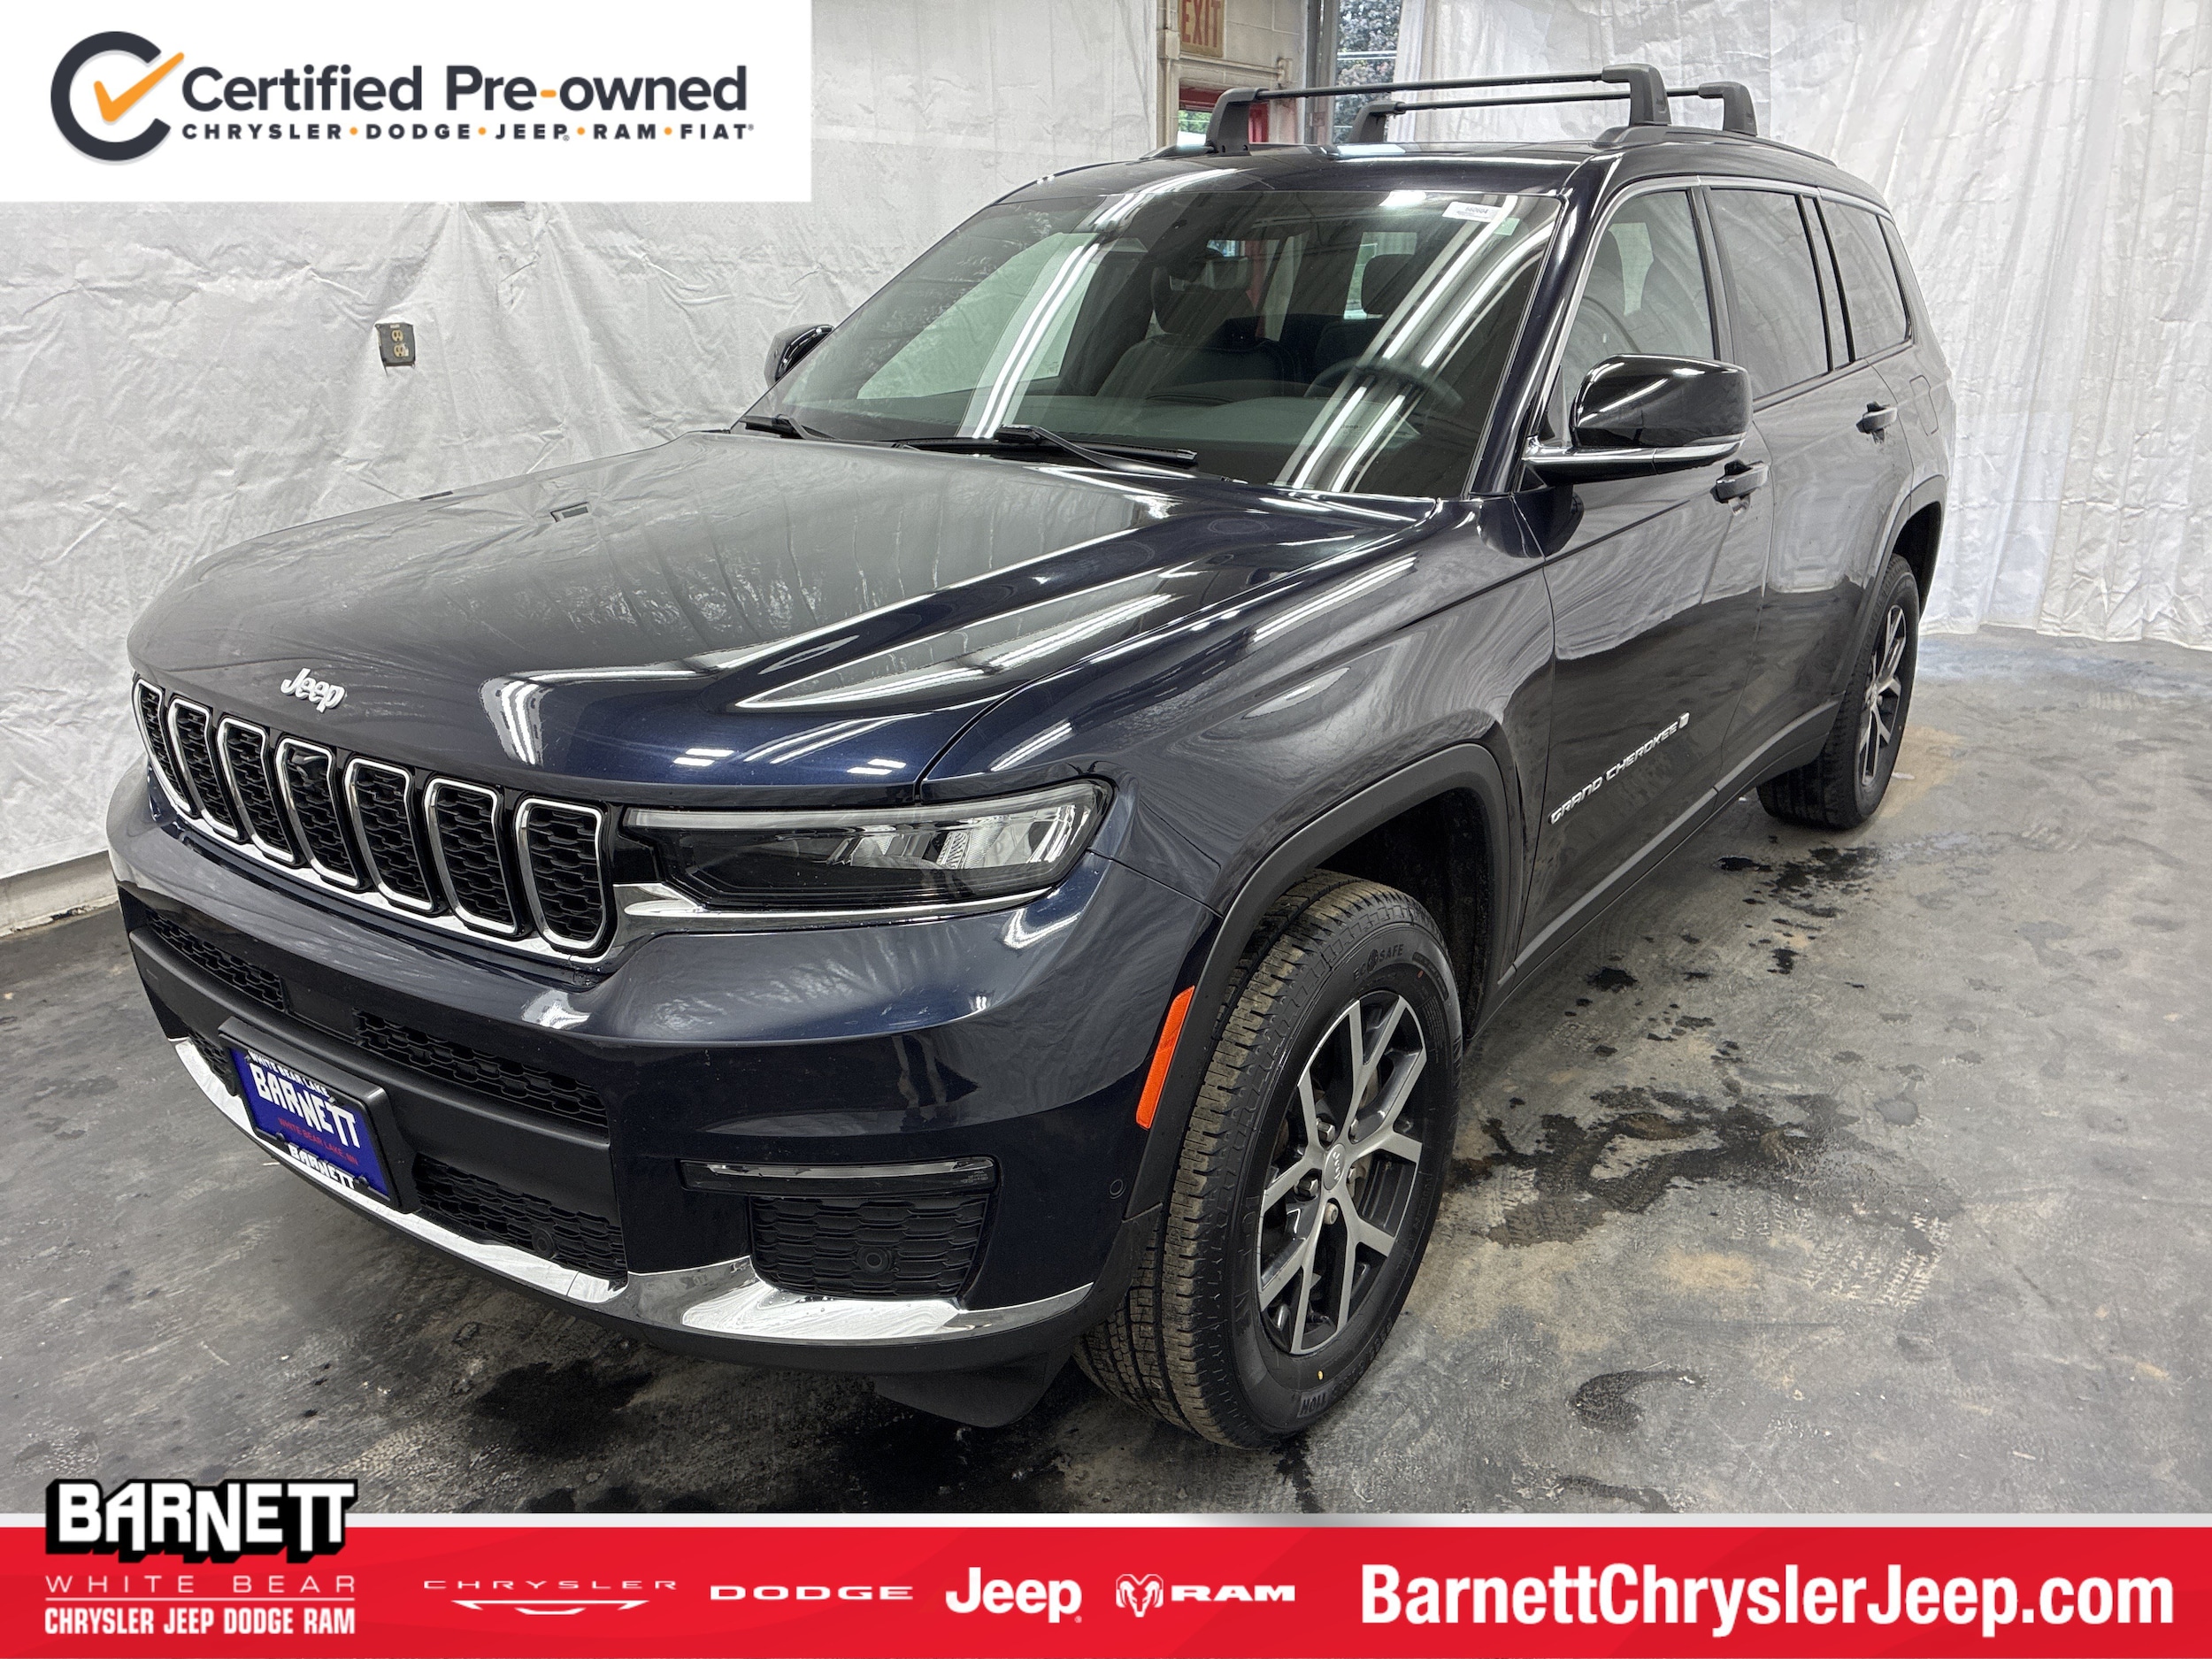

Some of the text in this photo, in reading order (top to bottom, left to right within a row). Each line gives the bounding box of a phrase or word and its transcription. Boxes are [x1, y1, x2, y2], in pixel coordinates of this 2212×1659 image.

[1182, 0, 1221, 48] EXIT
[280, 668, 345, 713] Jeep
[1550, 721, 1678, 825] GRAND CHEROKEE
[248, 1049, 331, 1098] WHITE BEAR LAKE
[249, 1063, 361, 1148] BARNETT
[278, 1117, 303, 1135] WHITE
[303, 1129, 324, 1147] BEAR
[287, 1142, 355, 1190] BARNETT
